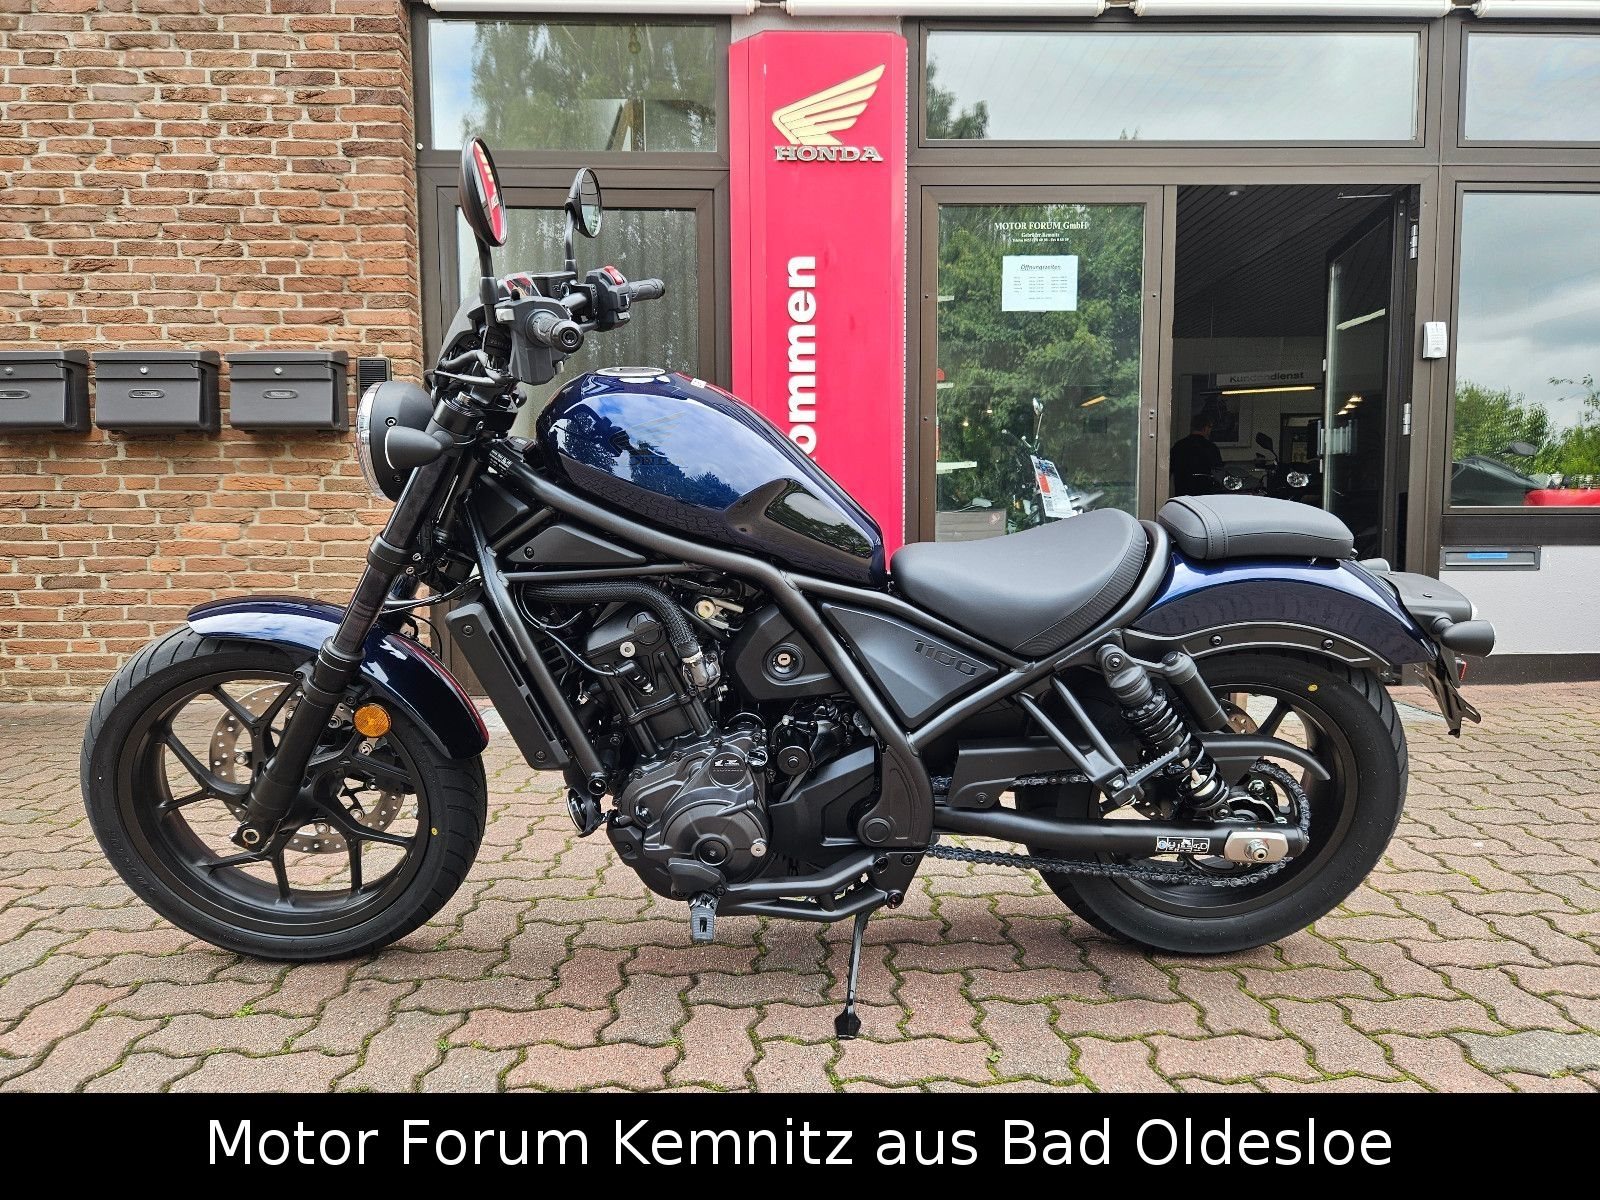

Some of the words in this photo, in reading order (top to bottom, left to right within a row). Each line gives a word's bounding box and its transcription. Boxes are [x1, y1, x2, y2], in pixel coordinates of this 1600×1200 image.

[774, 145, 884, 162] HONDA
[994, 222, 1027, 230] MOTOR
[1029, 222, 1062, 230] FORUM
[1063, 222, 1088, 230] GmbH
[787, 256, 817, 461] ommen
[914, 639, 978, 677] 1100
